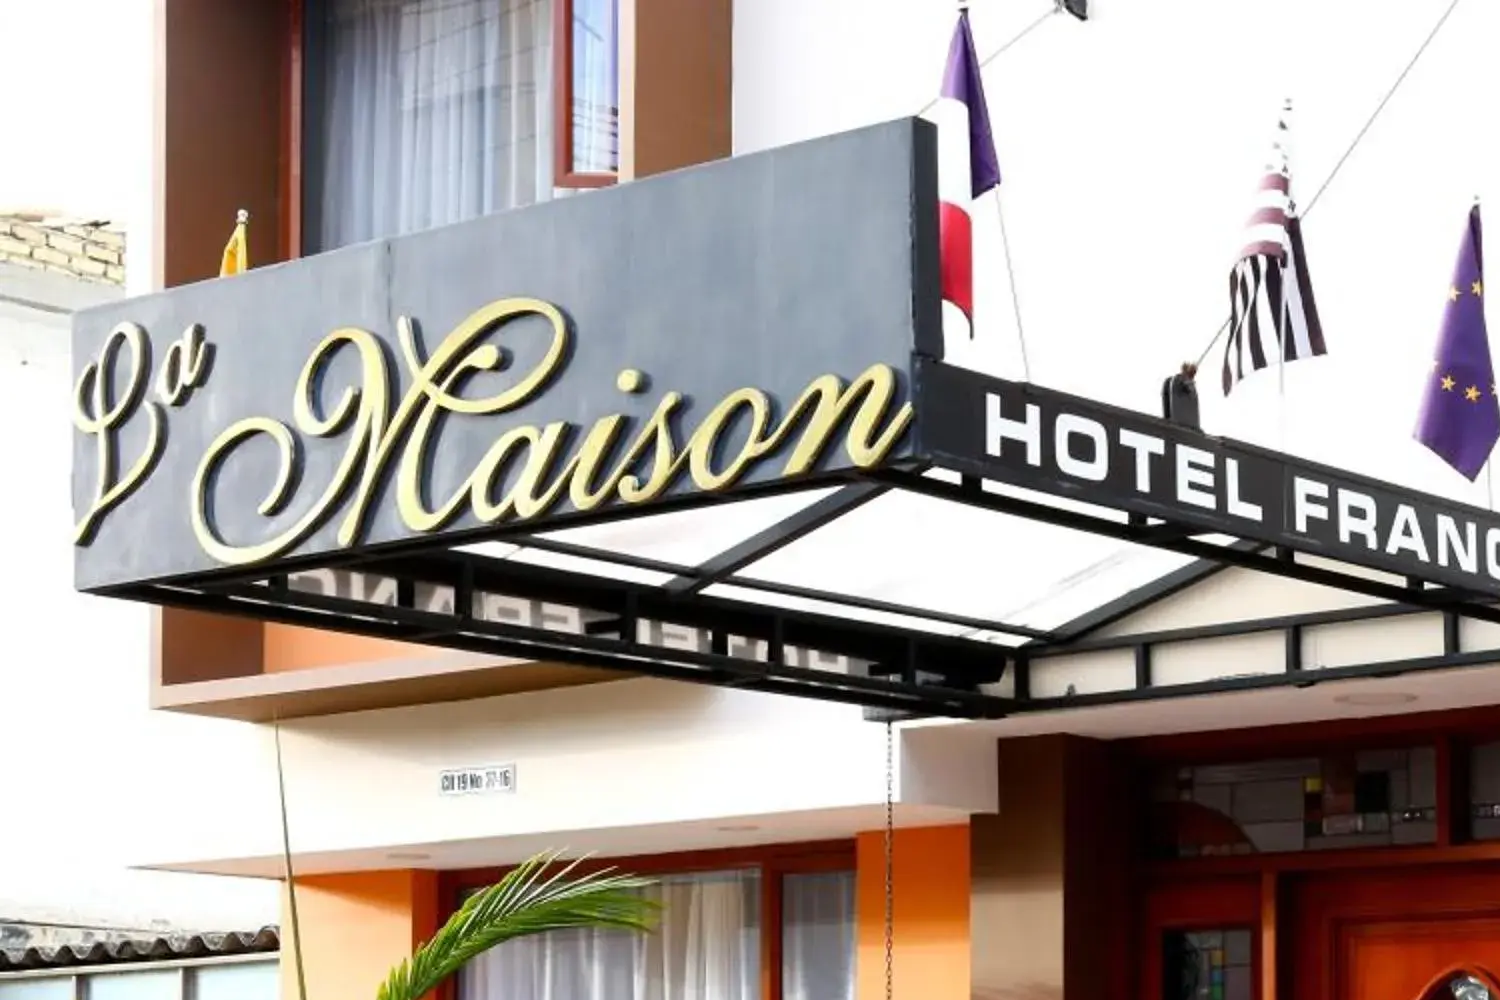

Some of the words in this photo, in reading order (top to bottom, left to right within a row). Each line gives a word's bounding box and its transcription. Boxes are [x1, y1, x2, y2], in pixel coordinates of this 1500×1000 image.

[73, 320, 214, 546] La
[190, 297, 914, 565] Maison
[985, 391, 1263, 522] HOTEL
